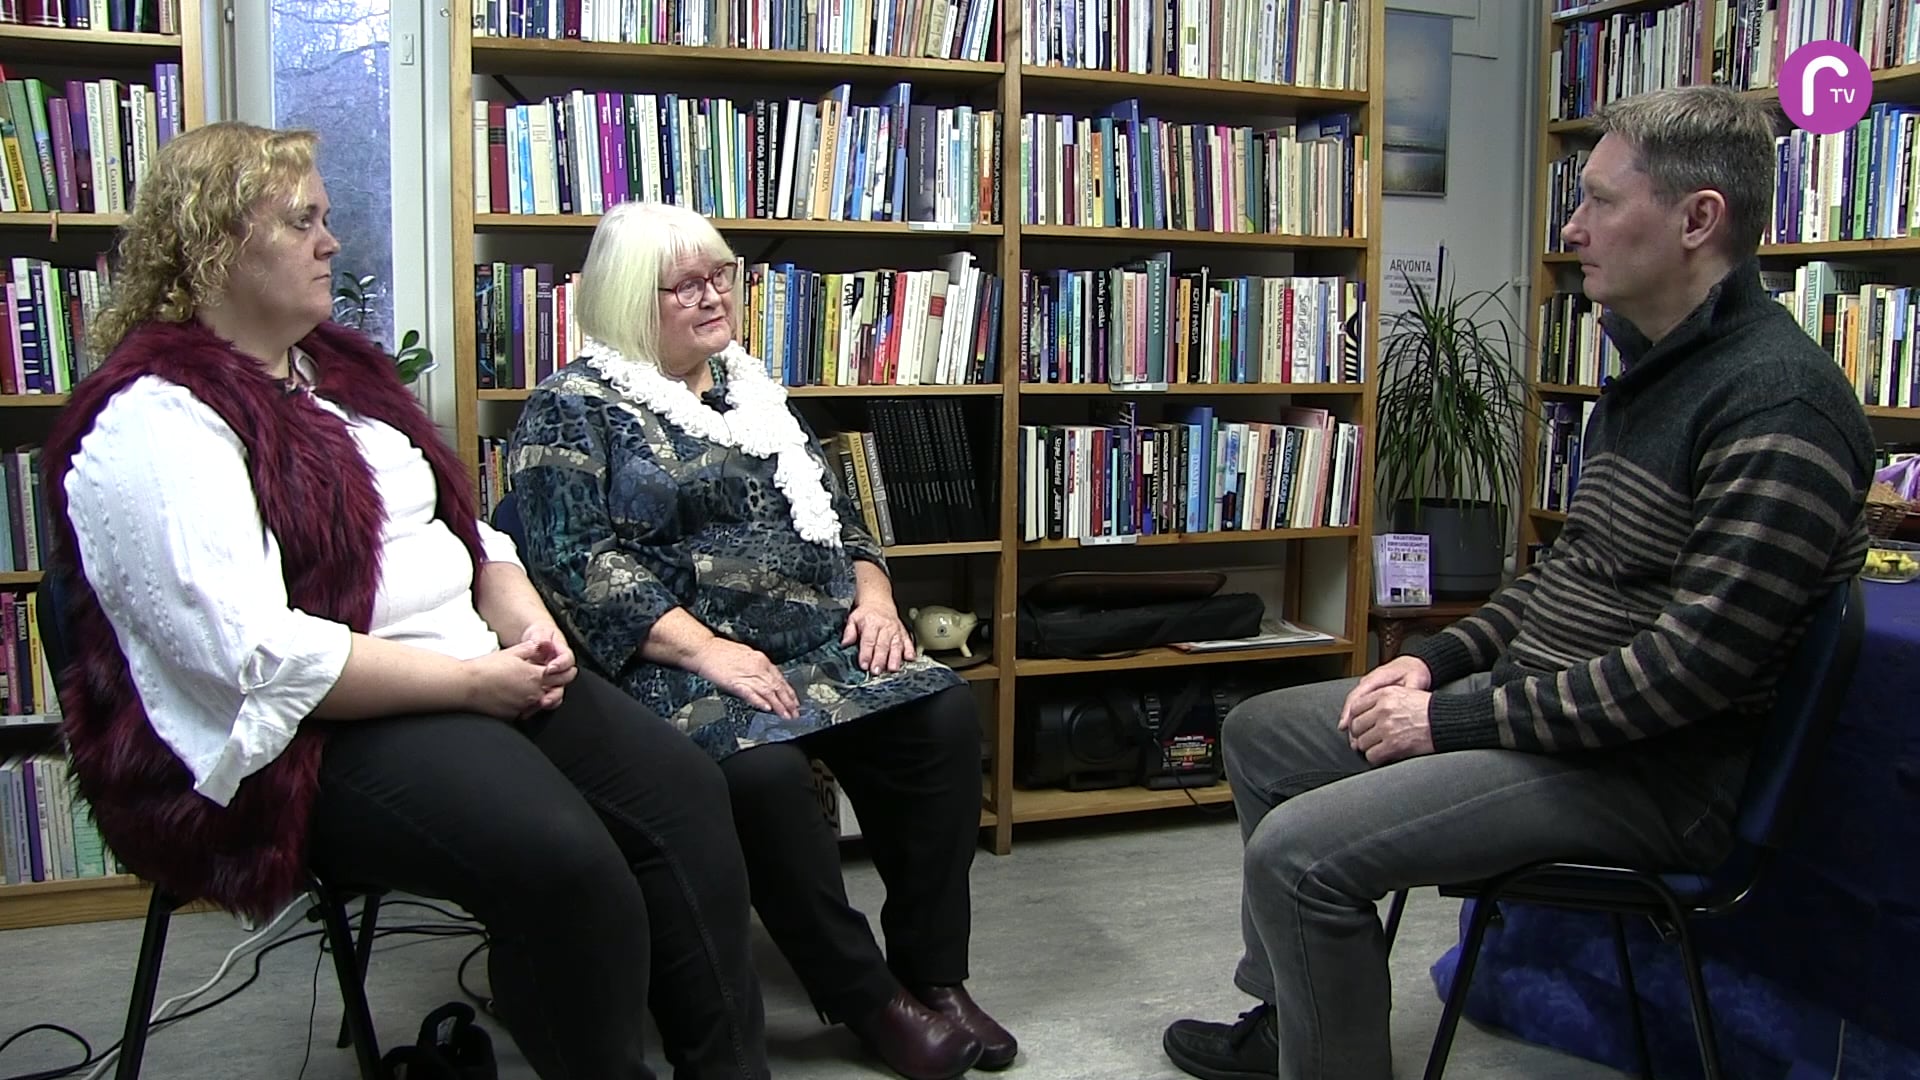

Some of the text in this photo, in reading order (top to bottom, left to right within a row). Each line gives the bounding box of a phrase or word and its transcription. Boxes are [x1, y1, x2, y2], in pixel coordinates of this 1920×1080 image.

[133, 90, 146, 162] Carlos Castaneda
[756, 116, 765, 132] 100
[756, 134, 765, 159] UFOA
[756, 160, 765, 208] SUOMESSA
[1389, 259, 1432, 273] ARVONTA
[1153, 263, 1161, 335] MAHABHARATA
[1192, 287, 1200, 312] KOHTI
[844, 461, 858, 500] HENGEN
